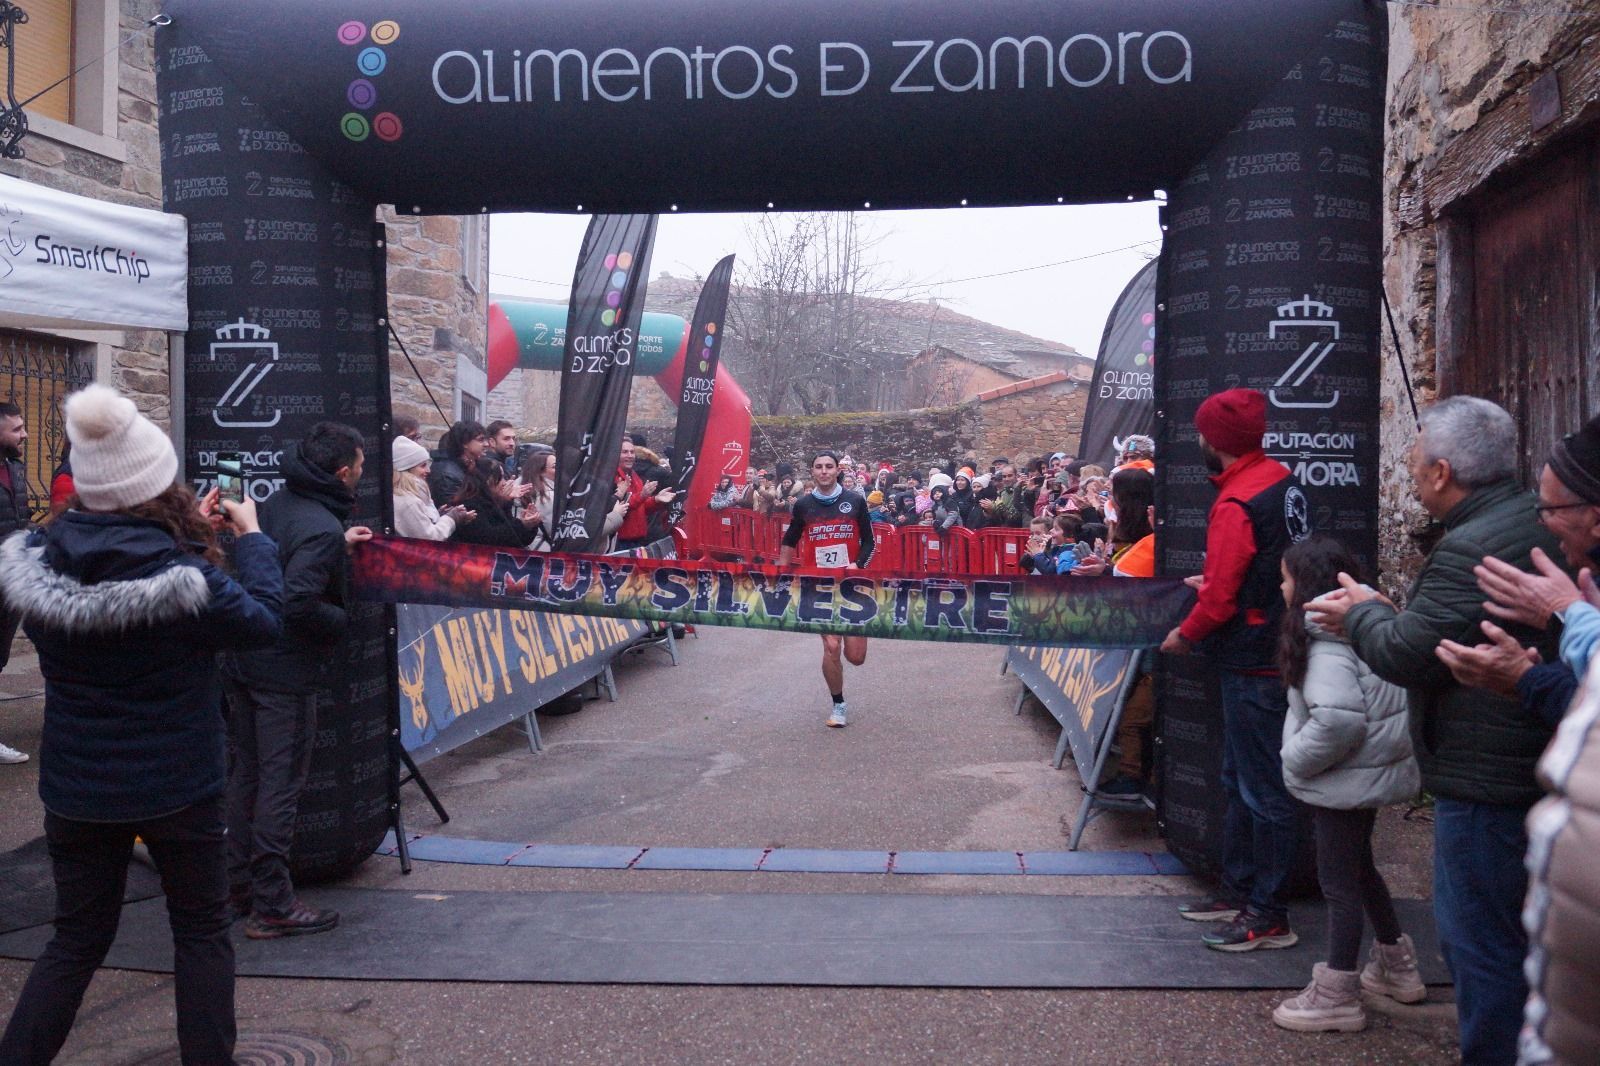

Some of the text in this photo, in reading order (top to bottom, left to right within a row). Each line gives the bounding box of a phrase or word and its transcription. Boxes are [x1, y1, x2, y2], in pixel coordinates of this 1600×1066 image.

[890, 30, 1192, 93] zamora
[1245, 208, 1295, 220] ZAMORA
[35, 234, 150, 283] SmartChip
[825, 551, 838, 563] 27
[491, 552, 1013, 632] MUY SILVESTRE
[434, 609, 512, 717] MUY
